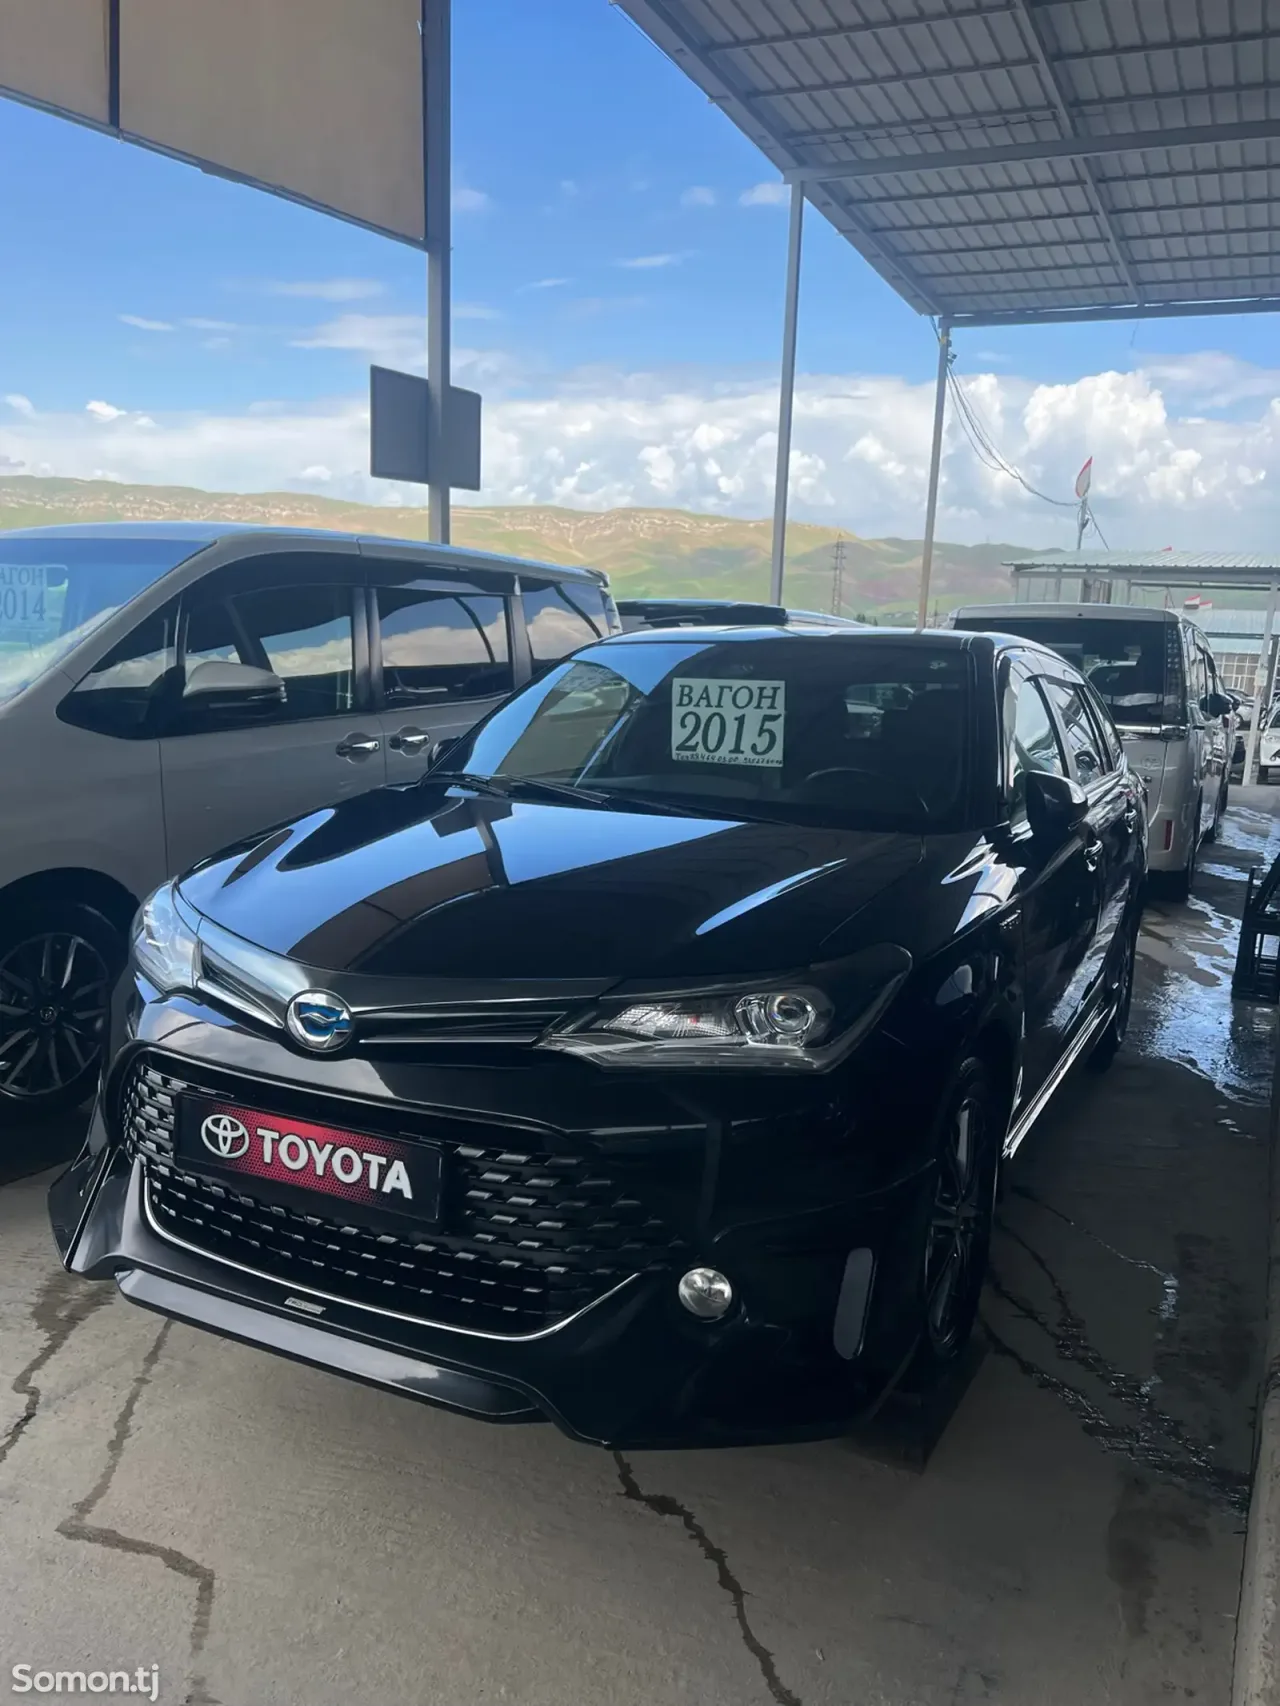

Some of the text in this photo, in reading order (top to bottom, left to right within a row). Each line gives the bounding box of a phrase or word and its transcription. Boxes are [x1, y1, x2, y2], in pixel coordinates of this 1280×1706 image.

[0, 588, 46, 621] 014
[676, 684, 781, 709] ВАГОН
[675, 711, 782, 756] 2015
[256, 1127, 413, 1200] TOYOTA
